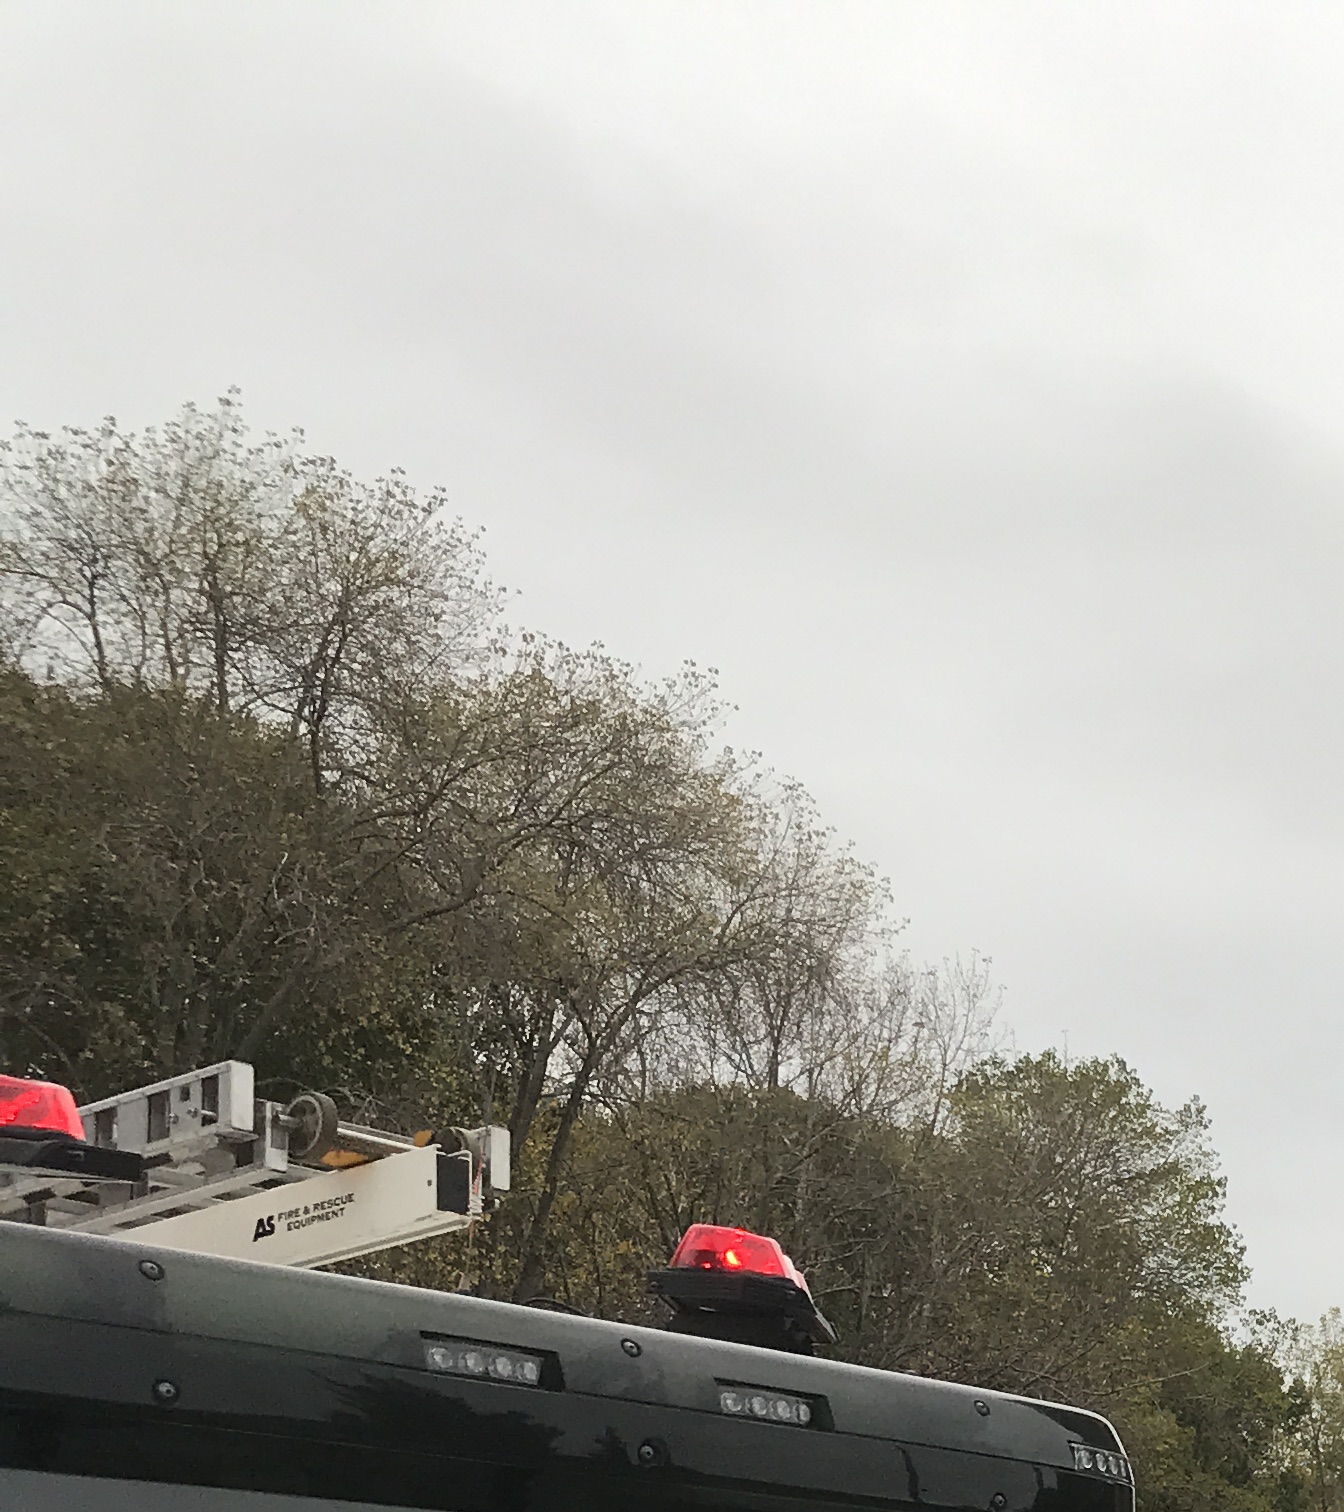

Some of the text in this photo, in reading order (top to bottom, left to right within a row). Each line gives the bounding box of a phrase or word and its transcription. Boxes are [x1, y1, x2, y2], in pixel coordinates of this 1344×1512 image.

[277, 1192, 356, 1223] FIRE & RESCUE
[286, 1206, 346, 1232] EQUIPMENT
